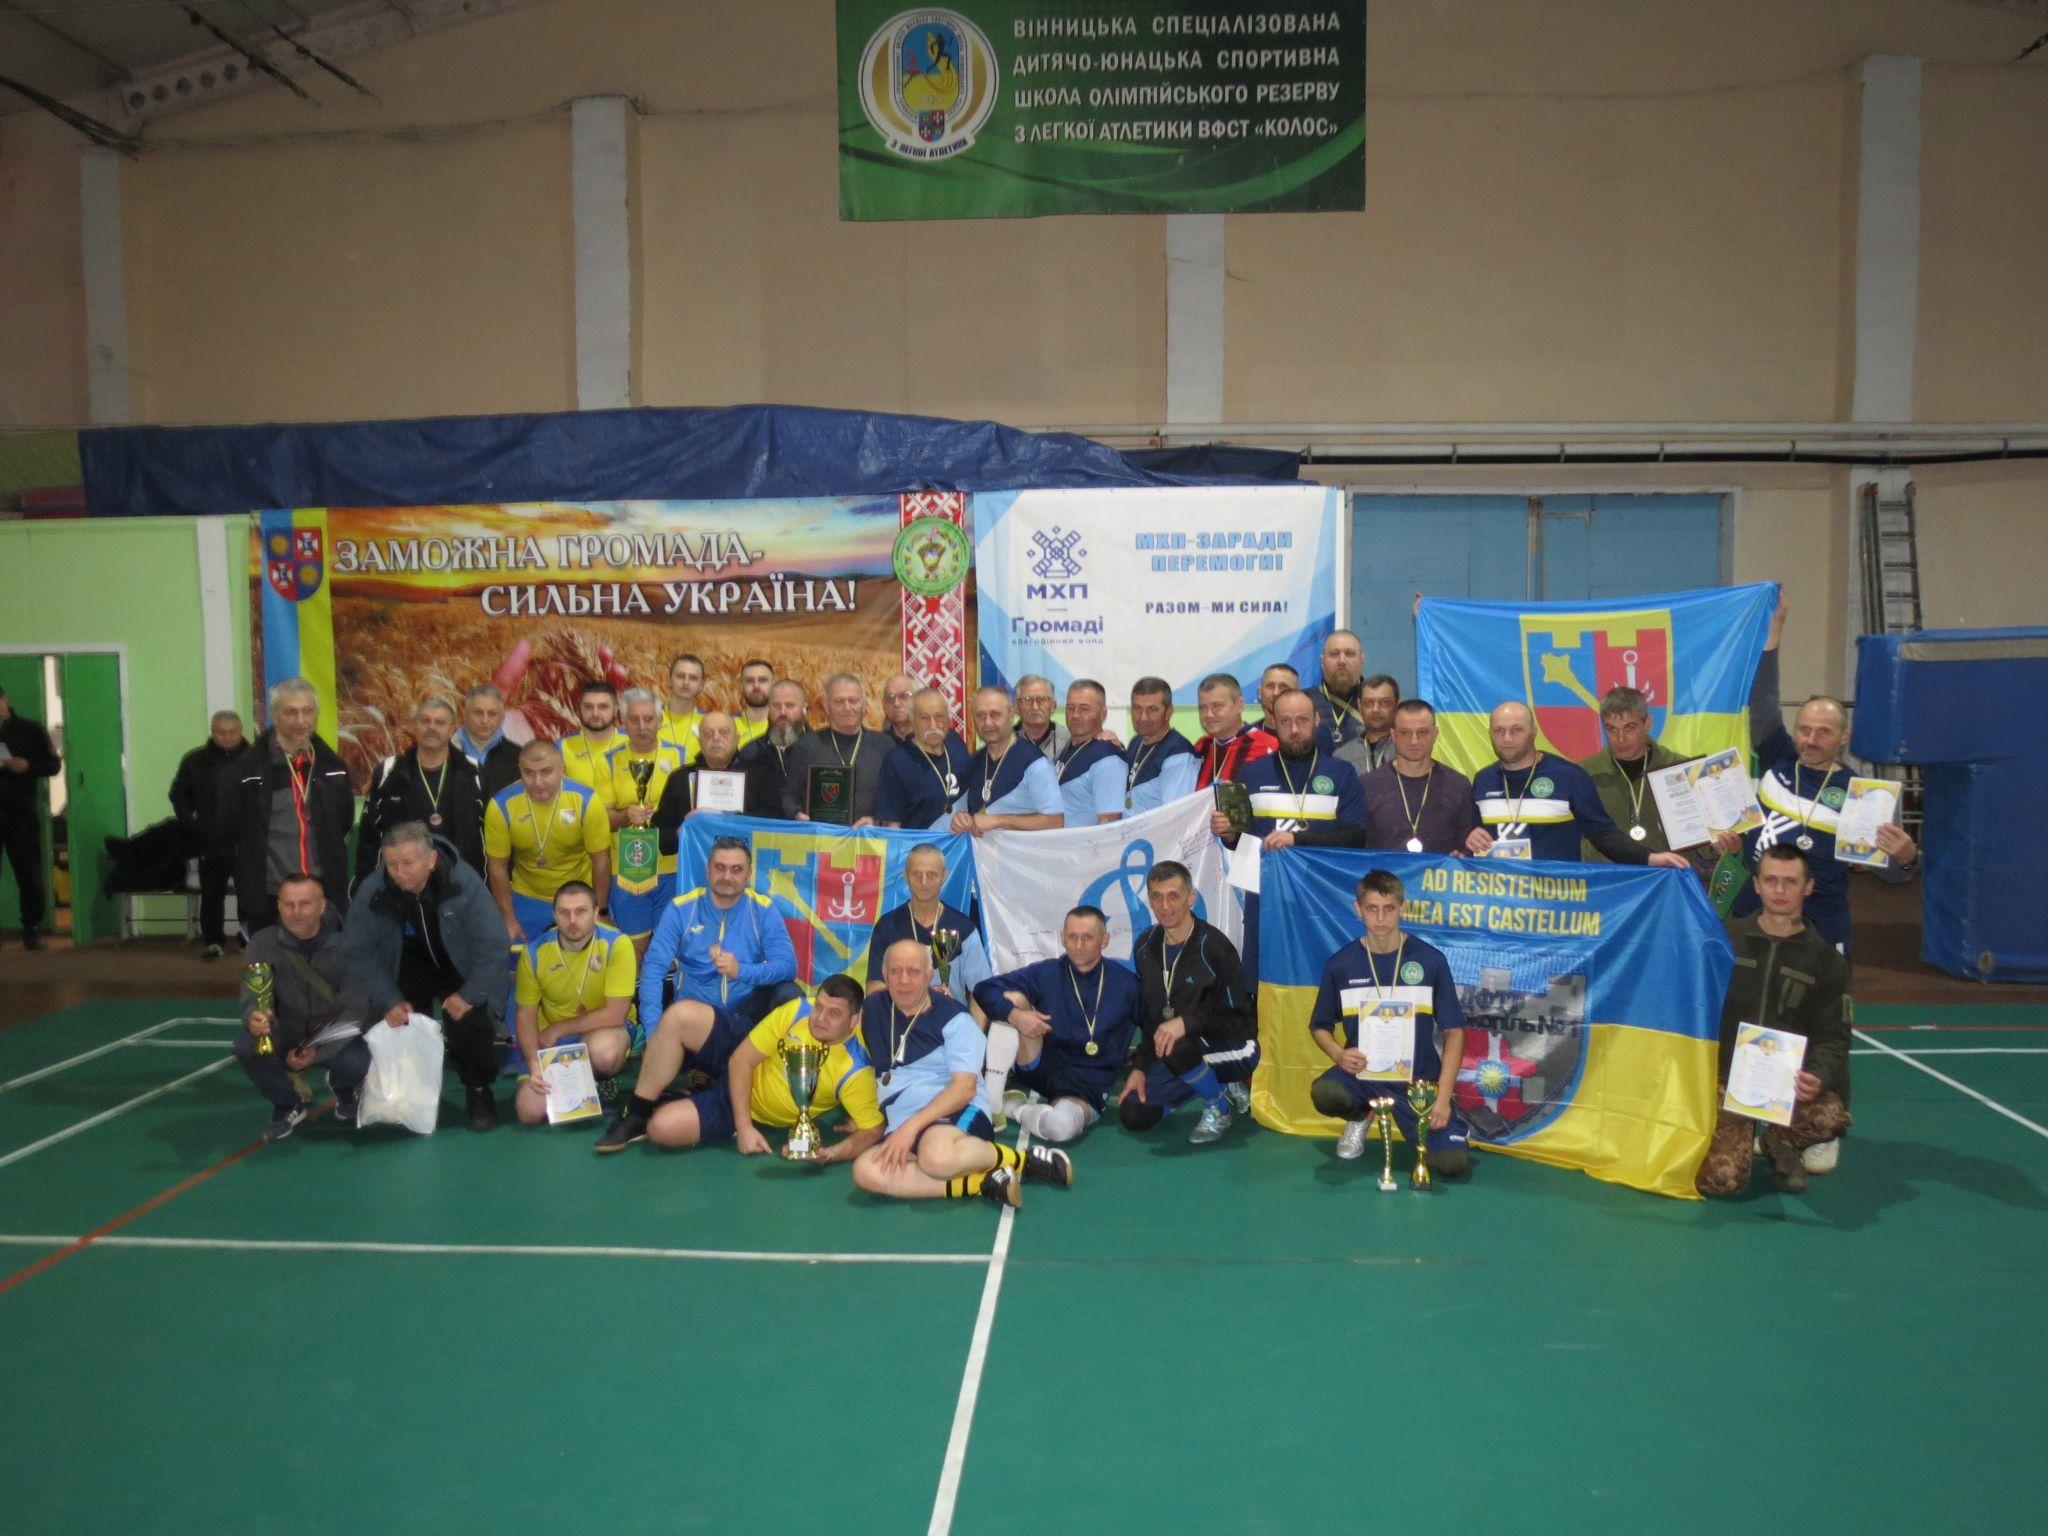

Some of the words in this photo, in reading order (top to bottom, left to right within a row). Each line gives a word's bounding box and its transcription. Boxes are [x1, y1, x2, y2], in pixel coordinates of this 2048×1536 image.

[1013, 16, 1137, 40] ВІННИЦЬКА
[1152, 11, 1340, 37] СПЕЦІАЛІЗОВАНА
[1013, 50, 1203, 76] ДИТЯЧО-ЮНАЦЬКА
[1217, 47, 1340, 69] СПОРТИВНА
[1014, 87, 1082, 108] ШКОЛА
[1089, 82, 1248, 106] ОЛІМПІЙСЬКОГО
[1256, 82, 1340, 103] РЕЗЕРВУ
[1014, 124, 1025, 143] З
[1030, 119, 1095, 142] ЛЕГКОЇ
[1099, 120, 1193, 140] АТЛЕТИКИ
[1198, 119, 1250, 139] ВФСТ
[1255, 117, 1338, 137] «КОЛОС»
[334, 536, 547, 573] ЗАМОЖНА
[557, 532, 764, 573] ГРОМАДА-
[1151, 554, 1284, 571] ПЕРЕМОГИ!
[481, 582, 651, 617] СИЛЬНА
[664, 573, 857, 615] УКРАЇНА!
[1026, 582, 1088, 600] МХП
[1239, 601, 1288, 614] СИЛА!
[1011, 615, 1104, 637] Громаді
[1421, 868, 1448, 893] AD
[1452, 870, 1588, 902] RESISTENDUM
[1402, 899, 1443, 925] MEA
[1448, 902, 1485, 928] EST
[1488, 906, 1601, 936] CASTELLUM
